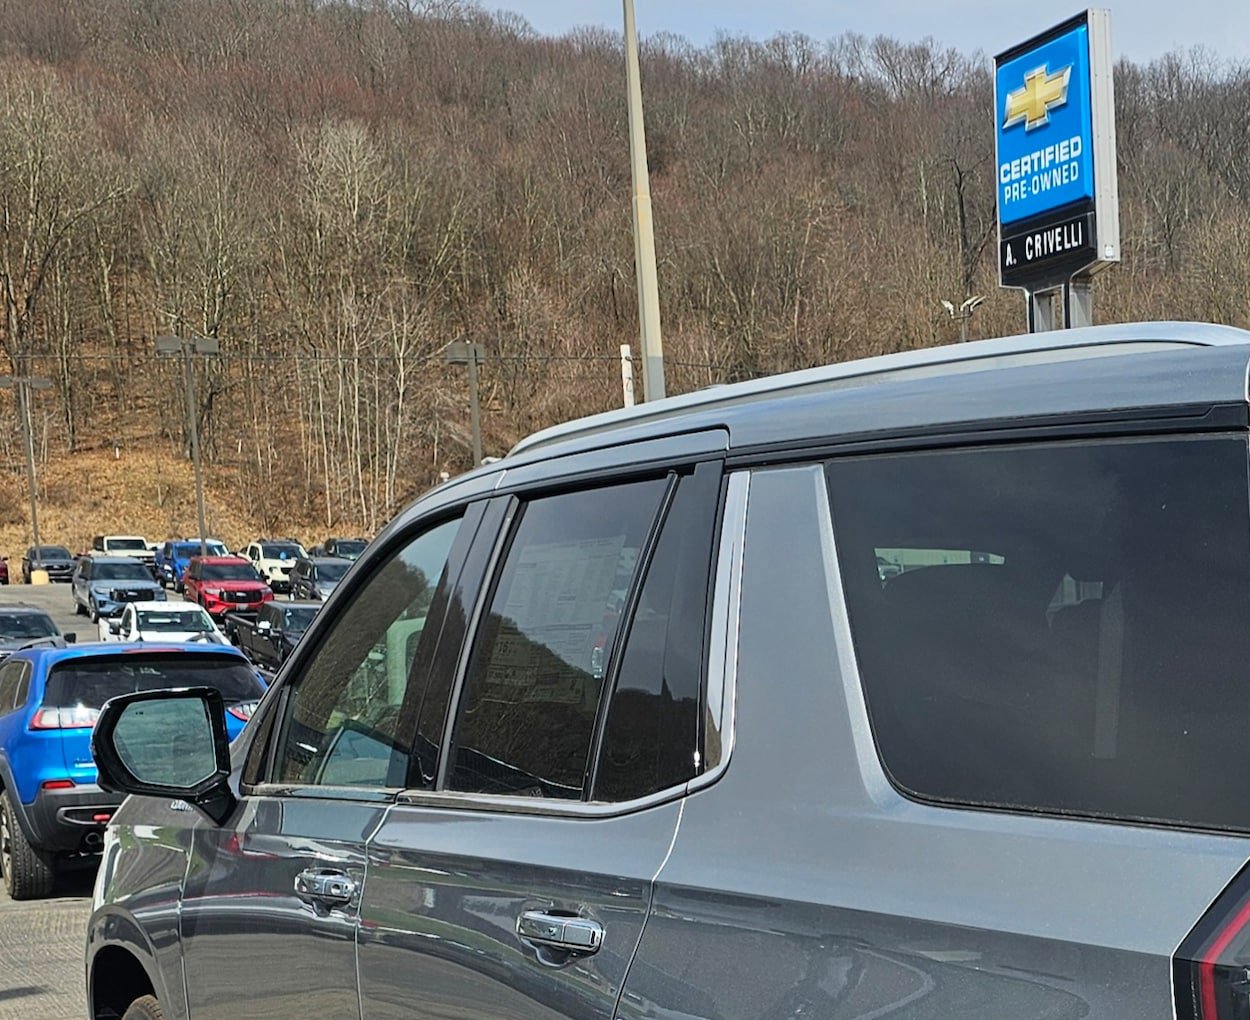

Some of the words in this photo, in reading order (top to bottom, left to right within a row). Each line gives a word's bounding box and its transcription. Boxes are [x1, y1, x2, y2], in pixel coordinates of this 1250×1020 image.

[1000, 136, 1082, 183] CERTIFIED
[1004, 161, 1079, 204] PRE-OWNED
[1005, 243, 1017, 267] A.
[1025, 221, 1083, 260] CRIVELLI
